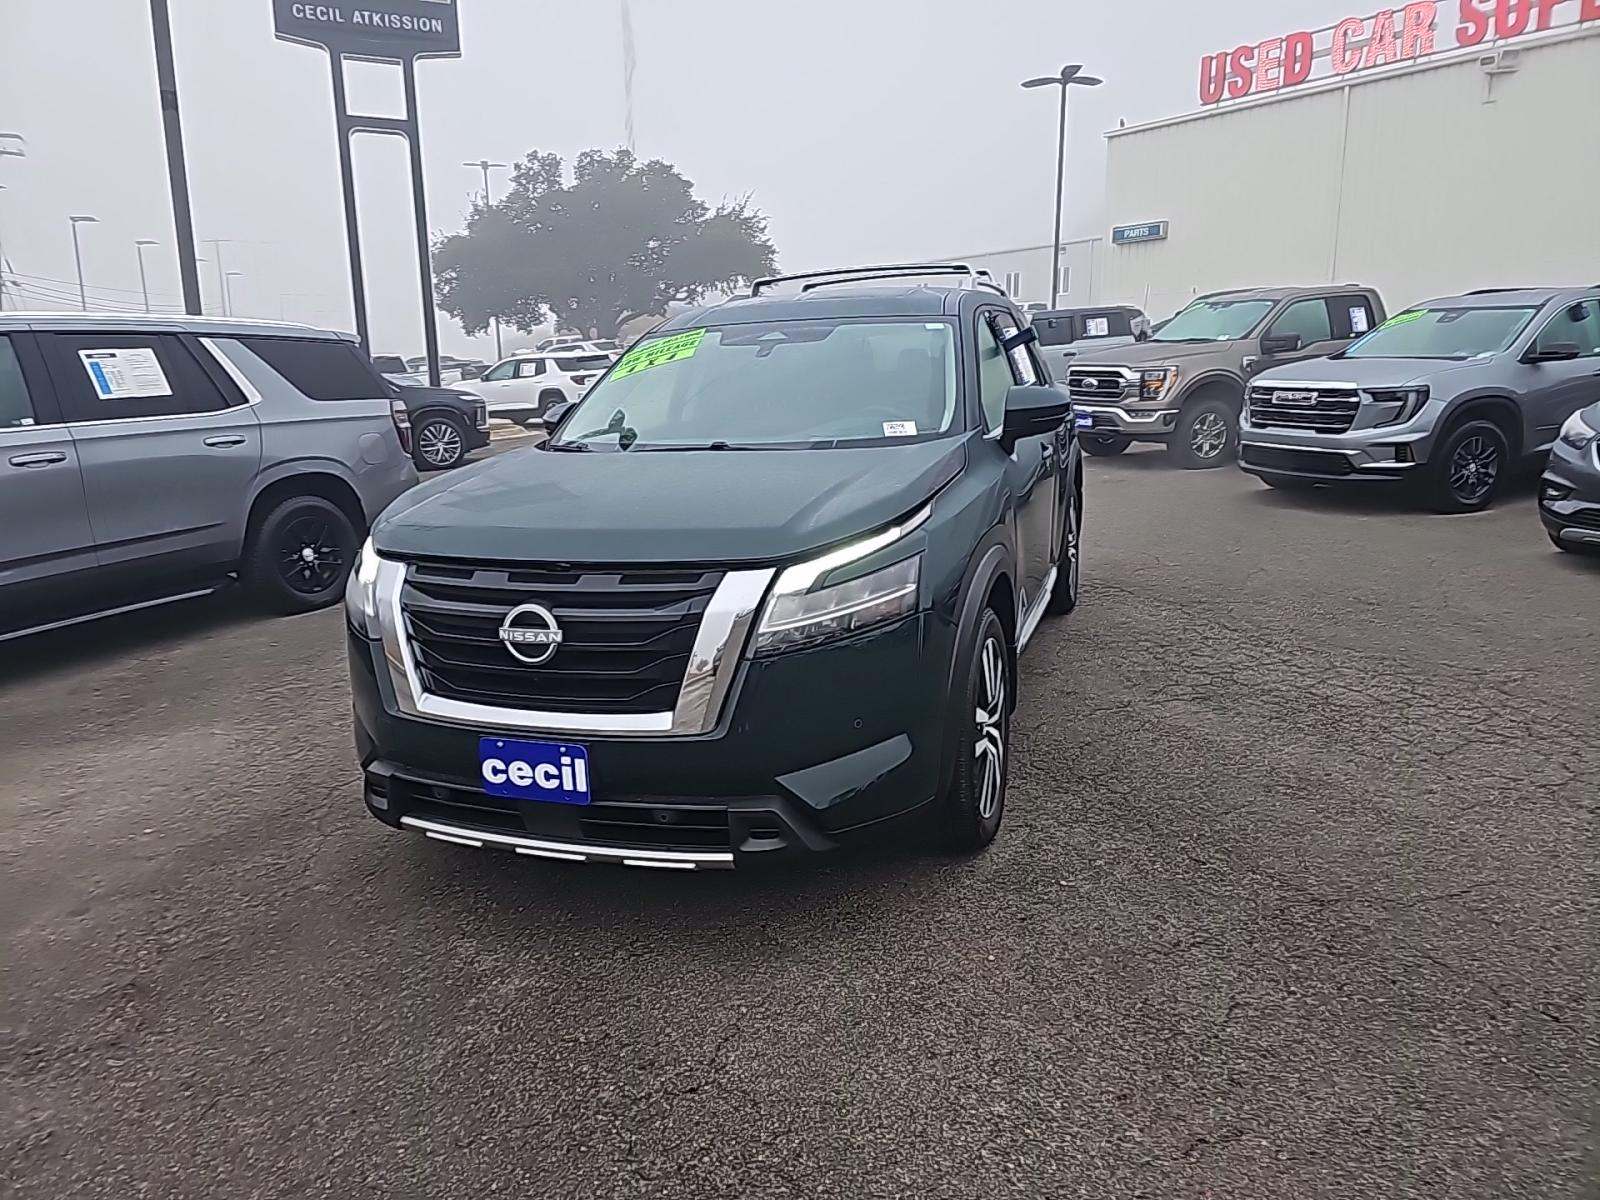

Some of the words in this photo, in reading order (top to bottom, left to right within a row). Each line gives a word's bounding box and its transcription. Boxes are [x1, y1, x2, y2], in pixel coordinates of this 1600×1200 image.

[292, 3, 345, 22] CECIL
[352, 10, 443, 33] ATKISSION
[1200, 31, 1313, 105] USED
[1332, 1, 1437, 73] CAR
[1123, 227, 1149, 238] PARTS
[500, 629, 562, 643] NISSAN
[482, 756, 588, 793] cecil
